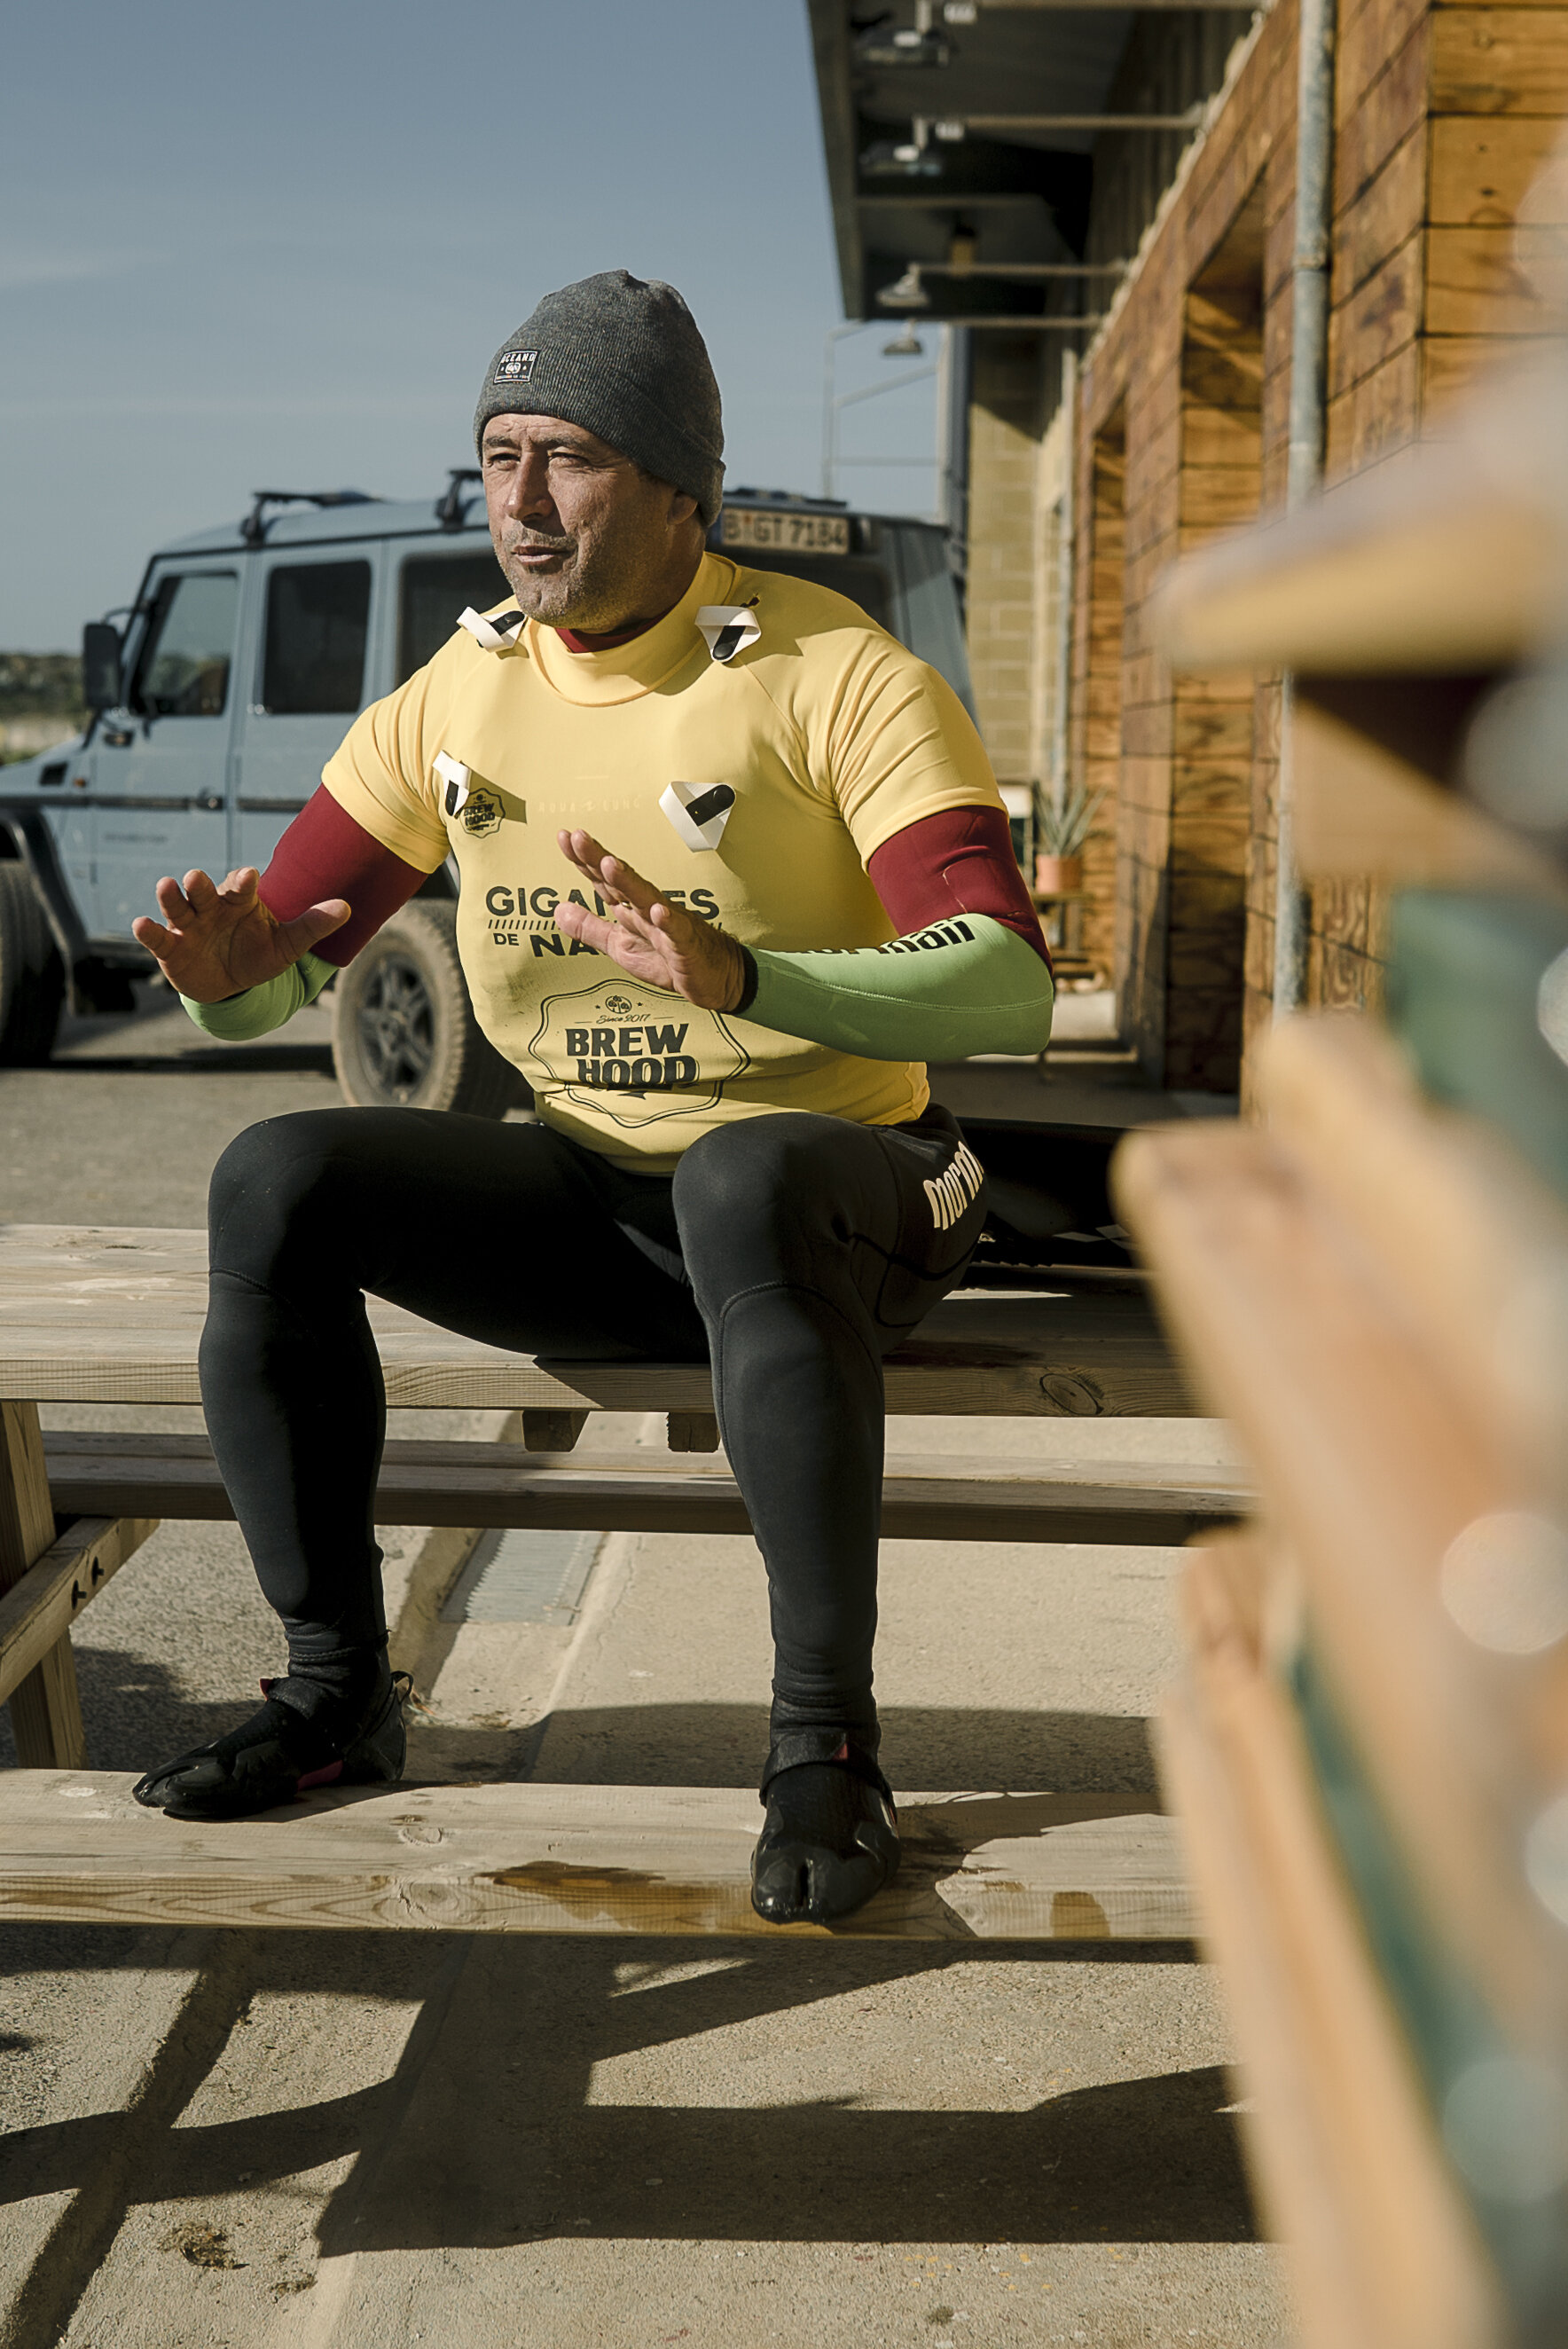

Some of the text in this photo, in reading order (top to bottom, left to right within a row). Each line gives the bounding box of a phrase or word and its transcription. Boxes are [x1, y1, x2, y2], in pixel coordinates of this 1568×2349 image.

[486, 886, 719, 920] GIGAES
[493, 933, 520, 947] DE
[623, 1013, 651, 1023] 2017
[565, 1023, 689, 1057] BREW
[577, 1055, 699, 1086] HOOD
[922, 1141, 984, 1230] morm
